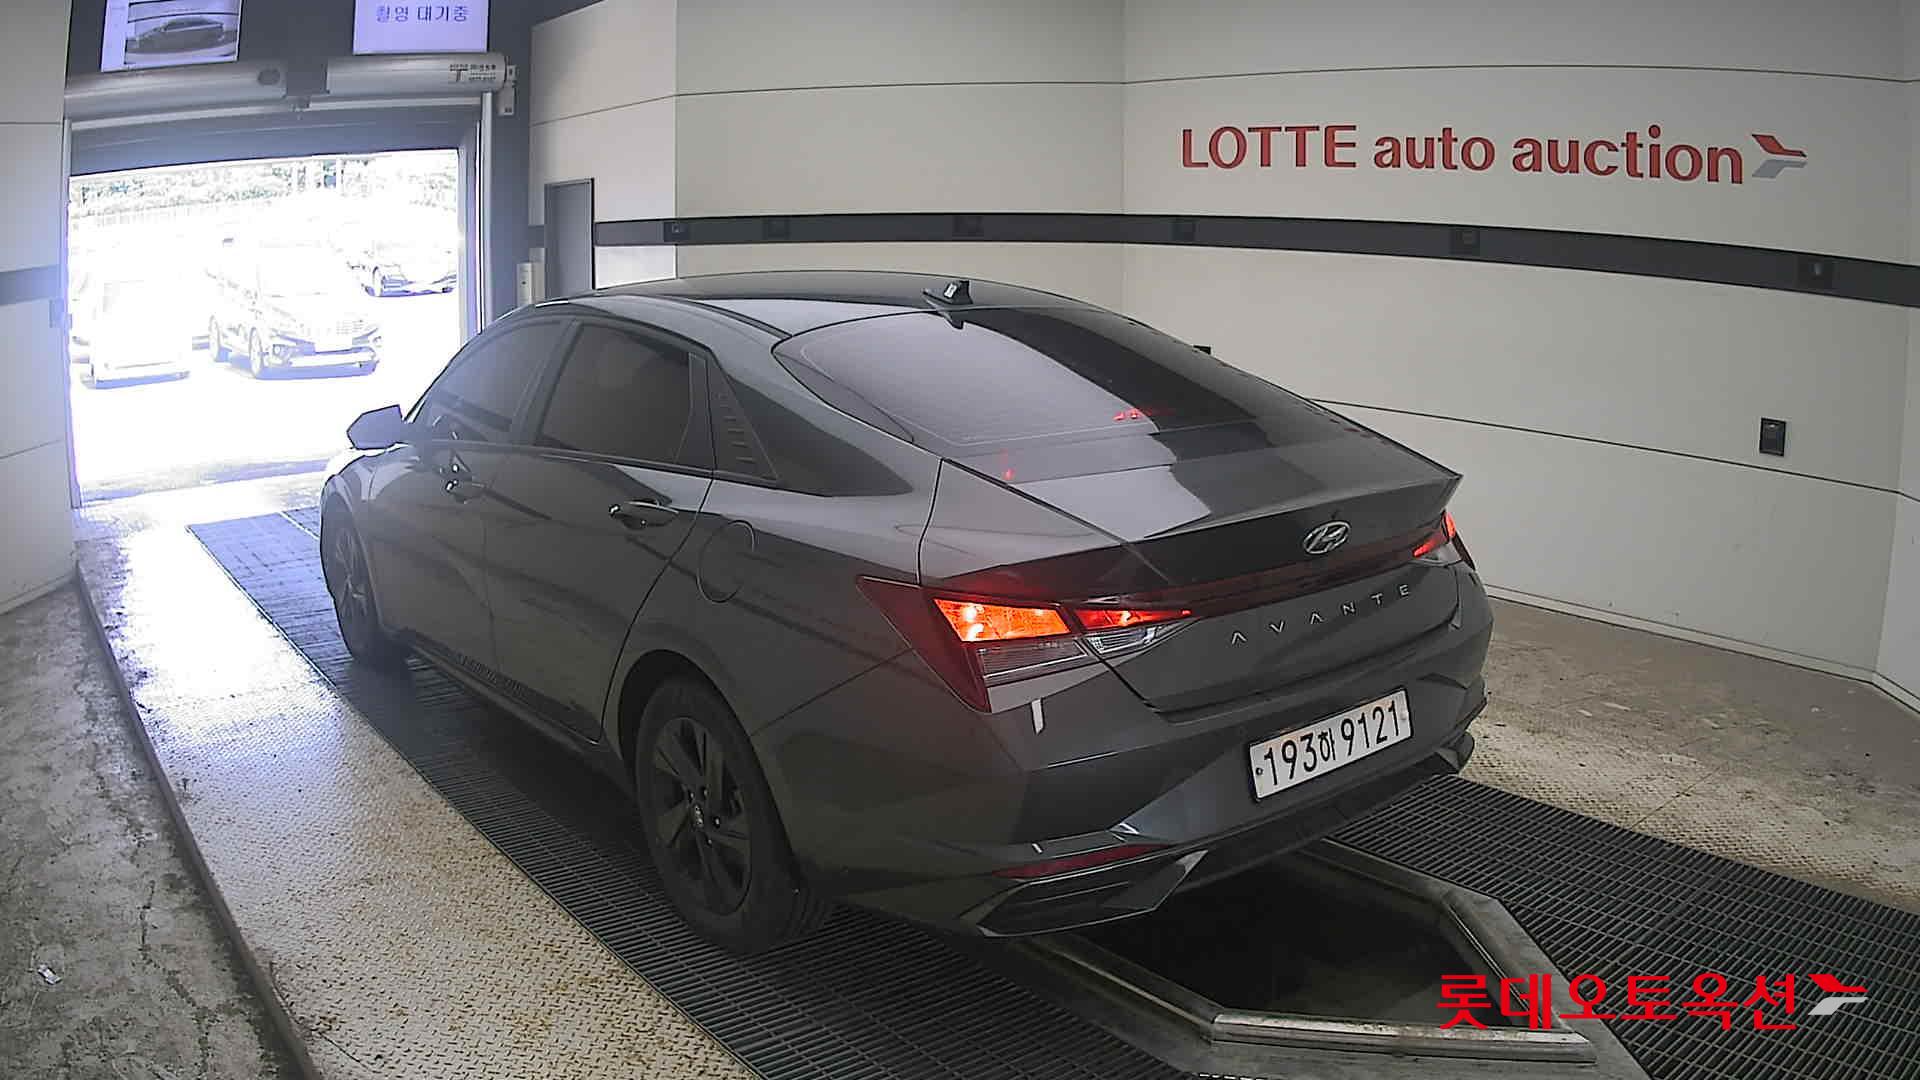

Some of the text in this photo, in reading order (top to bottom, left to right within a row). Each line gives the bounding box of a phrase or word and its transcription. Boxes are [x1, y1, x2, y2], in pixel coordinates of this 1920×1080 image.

[417, 5, 468, 22] 대기중
[1182, 124, 1743, 184] LOTTE auto auction
[1230, 584, 1410, 646] AVANTE
